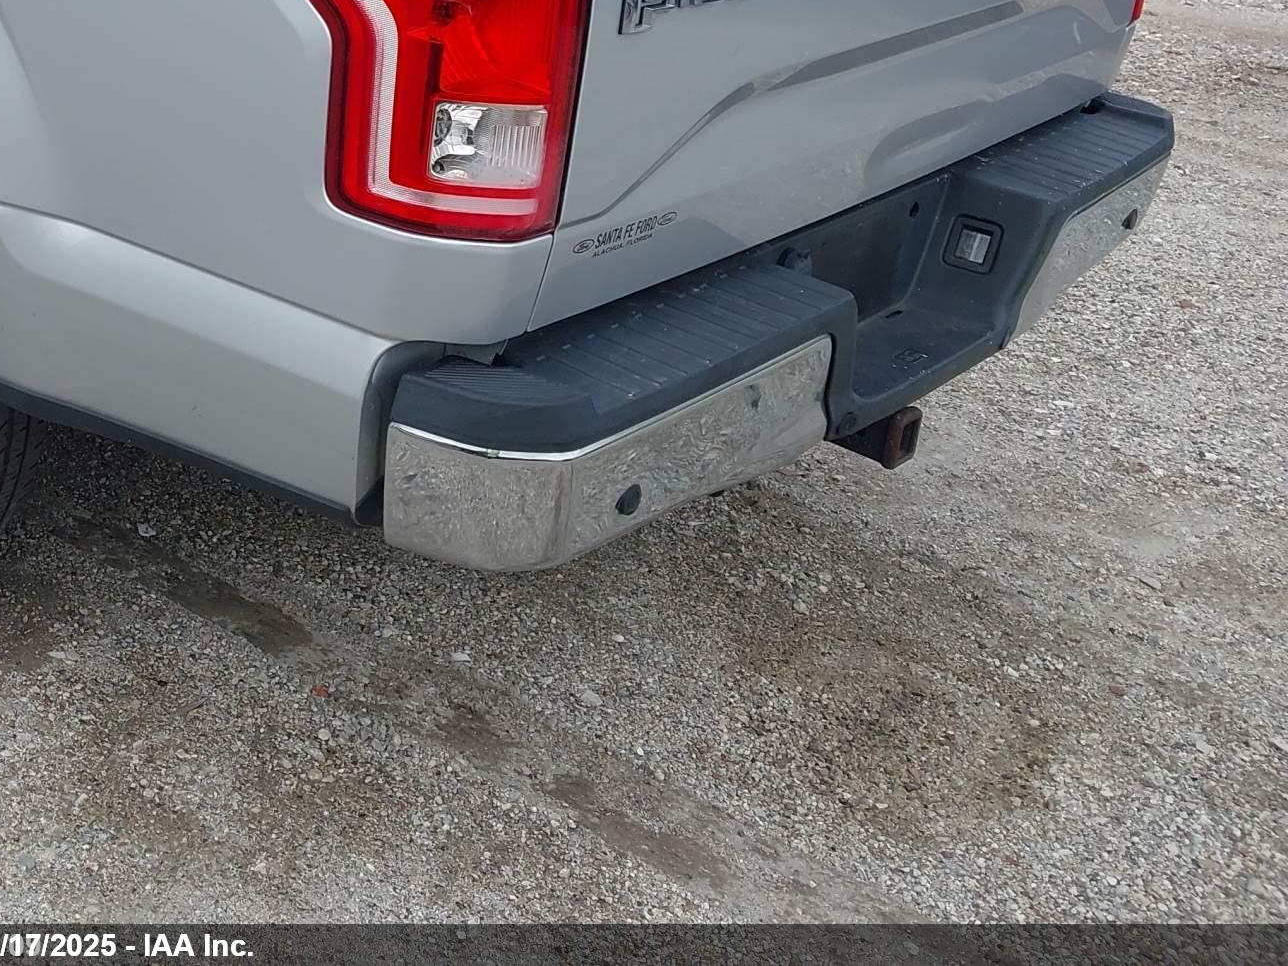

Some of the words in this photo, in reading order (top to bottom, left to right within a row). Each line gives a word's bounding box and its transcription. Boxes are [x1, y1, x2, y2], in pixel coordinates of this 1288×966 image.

[594, 226, 623, 249] SANTA
[622, 222, 636, 239] FE
[634, 216, 658, 235] FORD
[626, 233, 653, 246] FLORIDA
